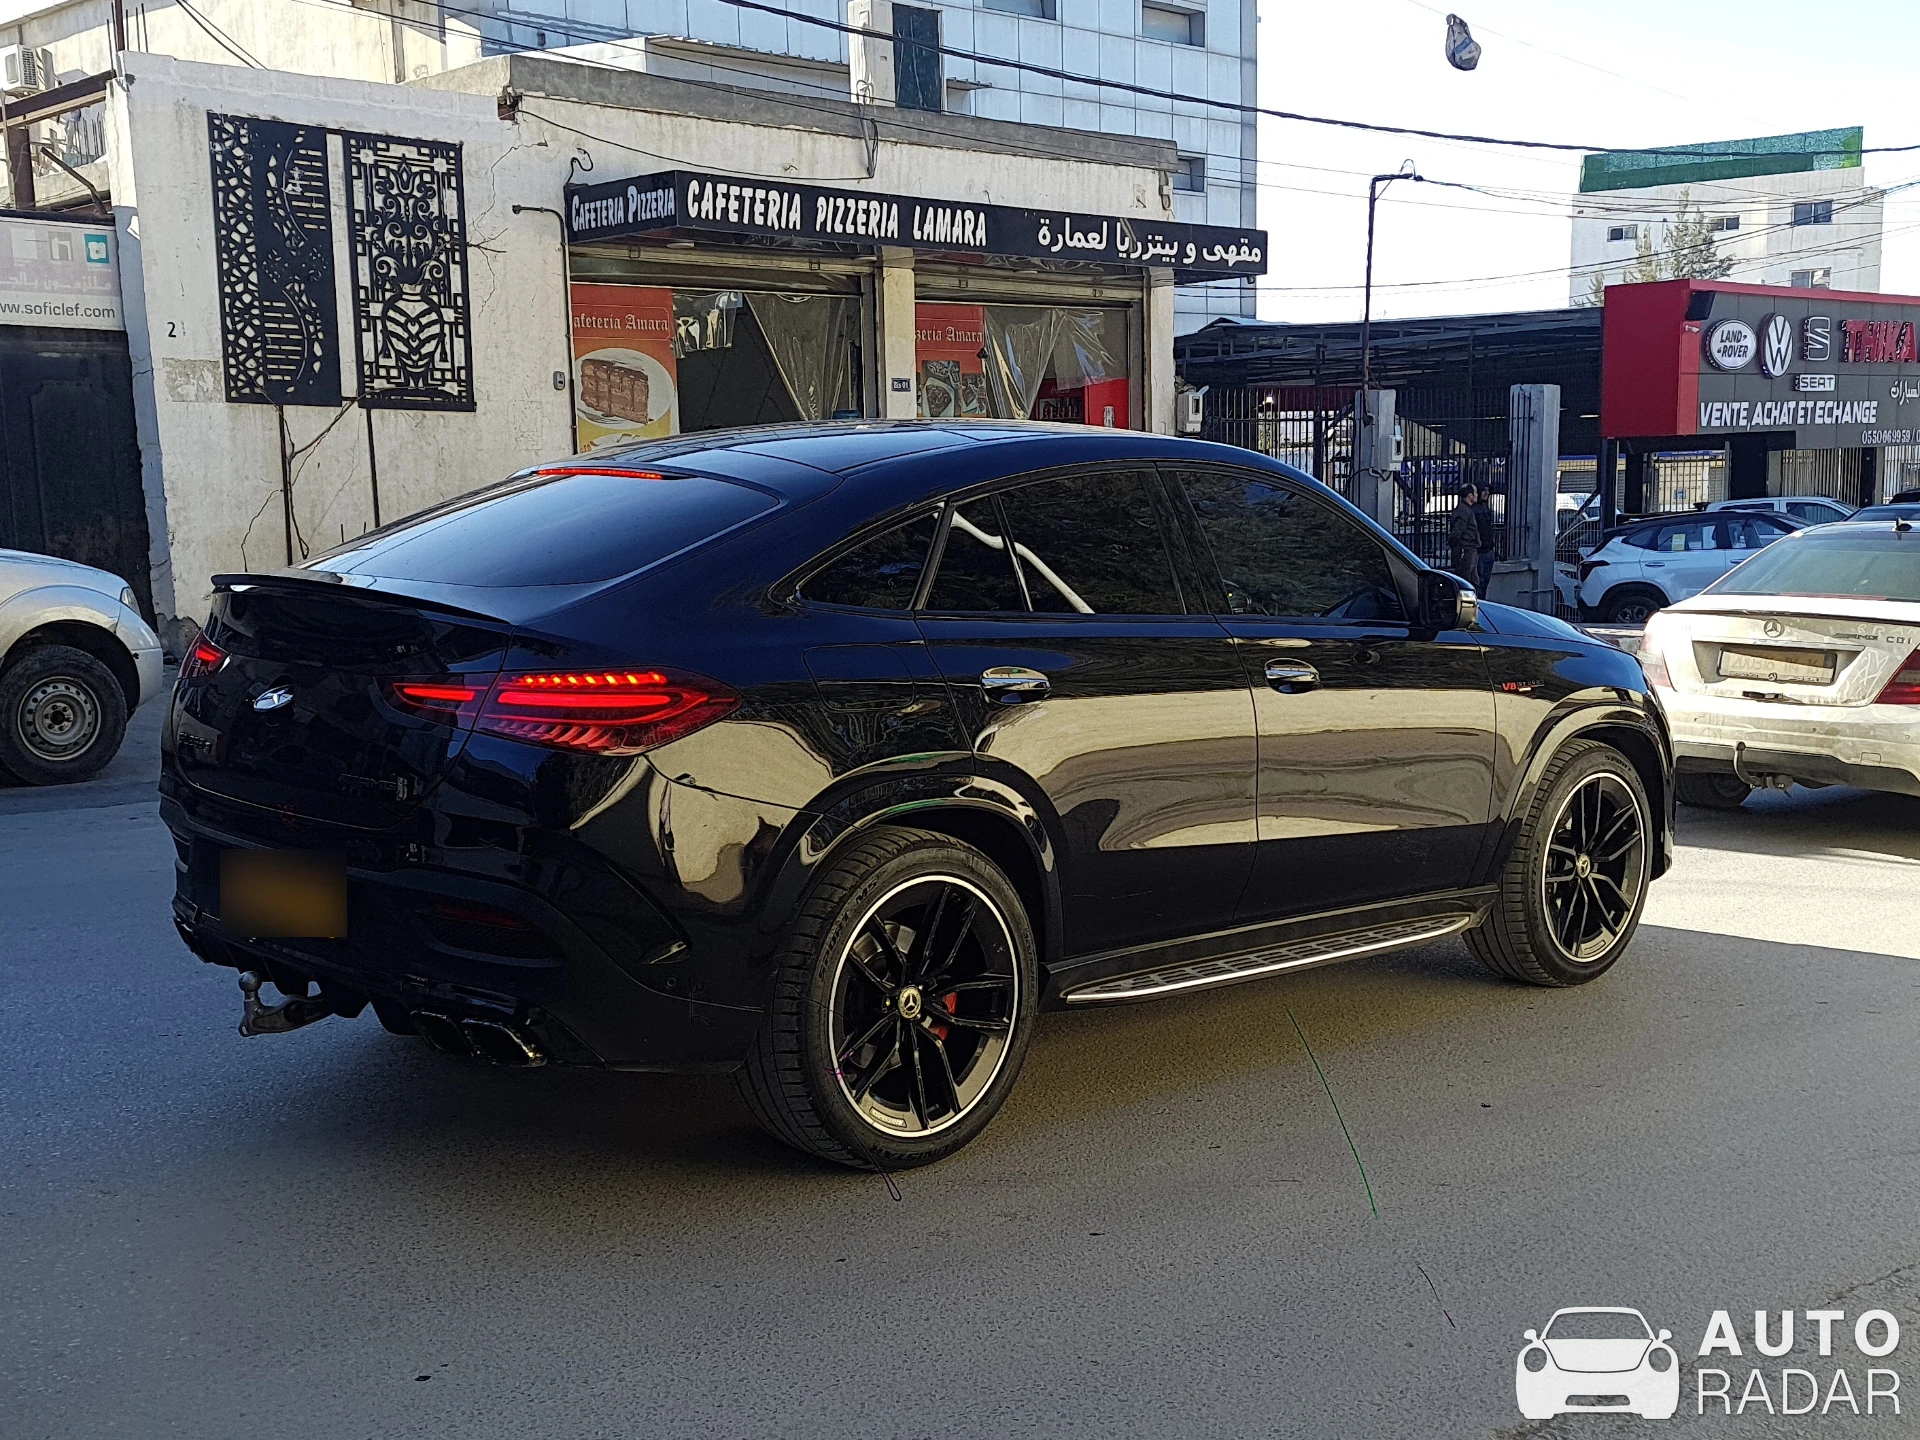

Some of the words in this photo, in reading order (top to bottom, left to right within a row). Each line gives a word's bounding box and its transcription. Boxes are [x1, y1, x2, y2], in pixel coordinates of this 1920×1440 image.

[572, 194, 624, 232] CAFETERIA
[627, 185, 675, 224] PIZZERIA
[687, 179, 800, 231] CAFETERIA
[815, 196, 899, 239] PIZZERIA
[913, 204, 986, 247] LAMARA
[1038, 217, 1108, 252] لعمارة
[1183, 242, 1196, 264] و
[1202, 237, 1262, 267] مقهى
[573, 312, 622, 330] afeteria
[625, 313, 668, 331] Amara
[946, 325, 982, 343] Amara
[1720, 329, 1742, 343] LAND
[1721, 344, 1749, 359] ROVER
[1800, 376, 1834, 389] SEAT
[1797, 400, 1814, 425] ET
[1814, 400, 1878, 425] ECHANGE
